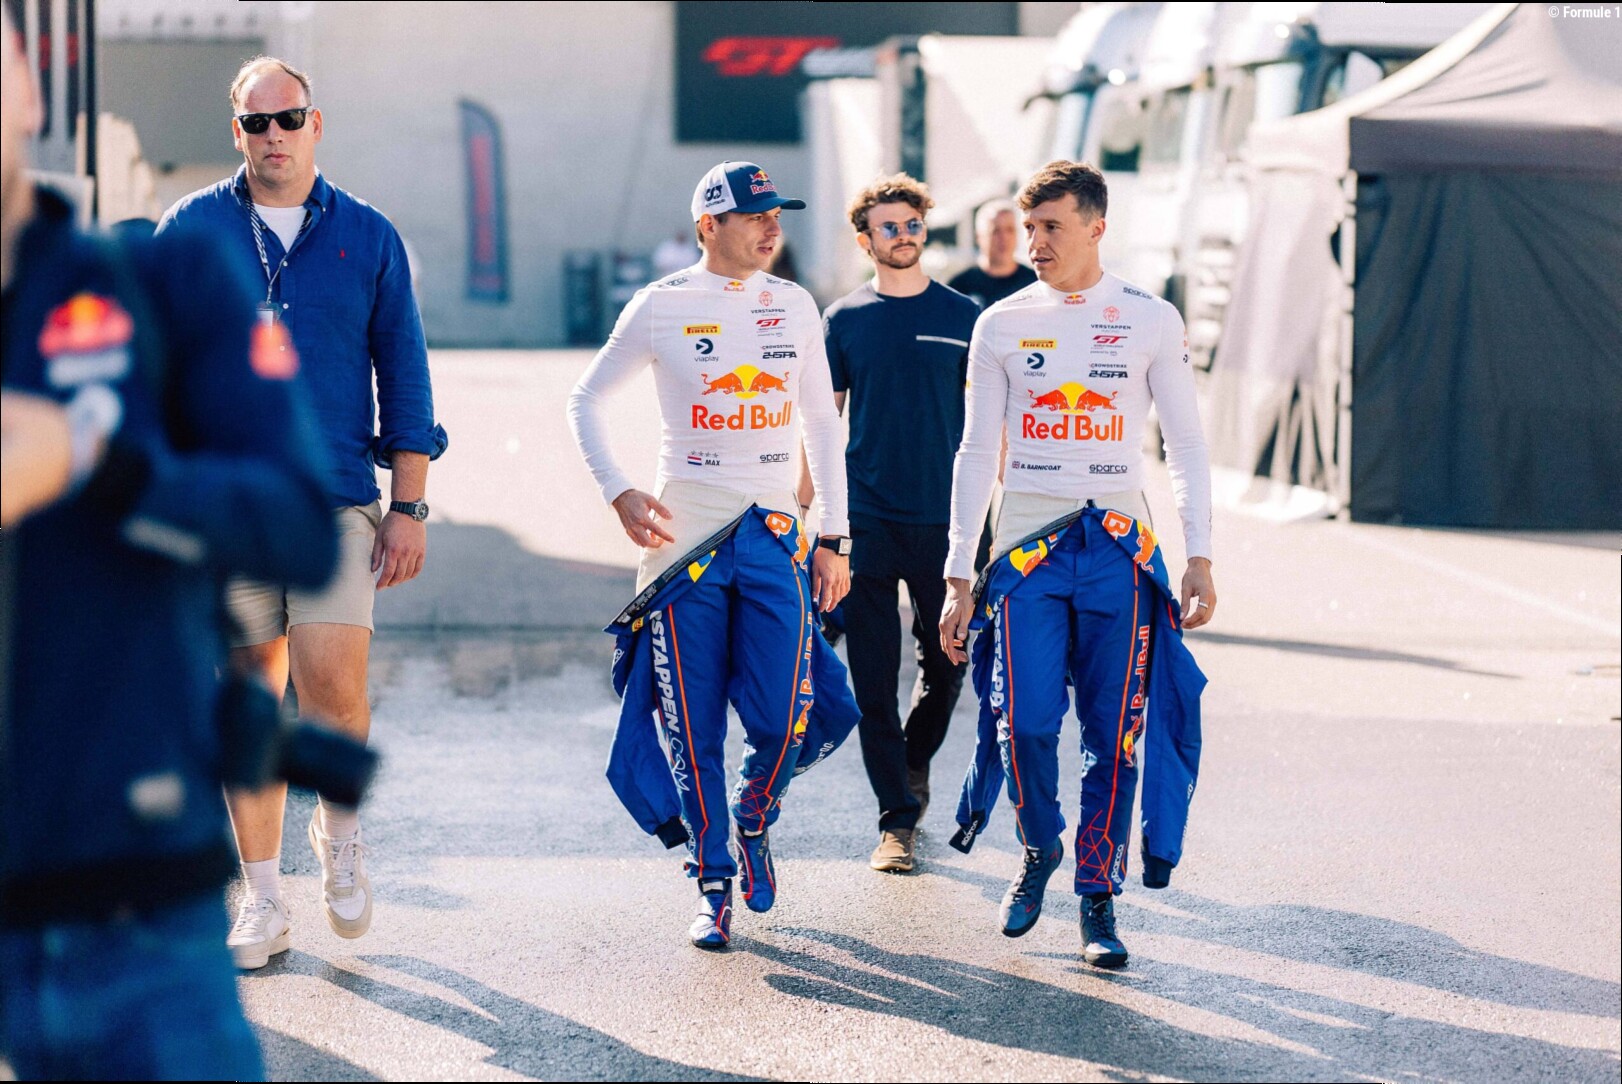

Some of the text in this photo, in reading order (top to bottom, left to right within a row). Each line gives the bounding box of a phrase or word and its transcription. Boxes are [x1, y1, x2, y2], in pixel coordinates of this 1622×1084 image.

[687, 325, 718, 334] PIRELLI
[1023, 370, 1047, 378] viaplay
[691, 401, 792, 431] Red Bull
[1022, 413, 1124, 441] Red Bull
[1026, 463, 1062, 471] BARNICOAT
[1089, 463, 1128, 474] sparco
